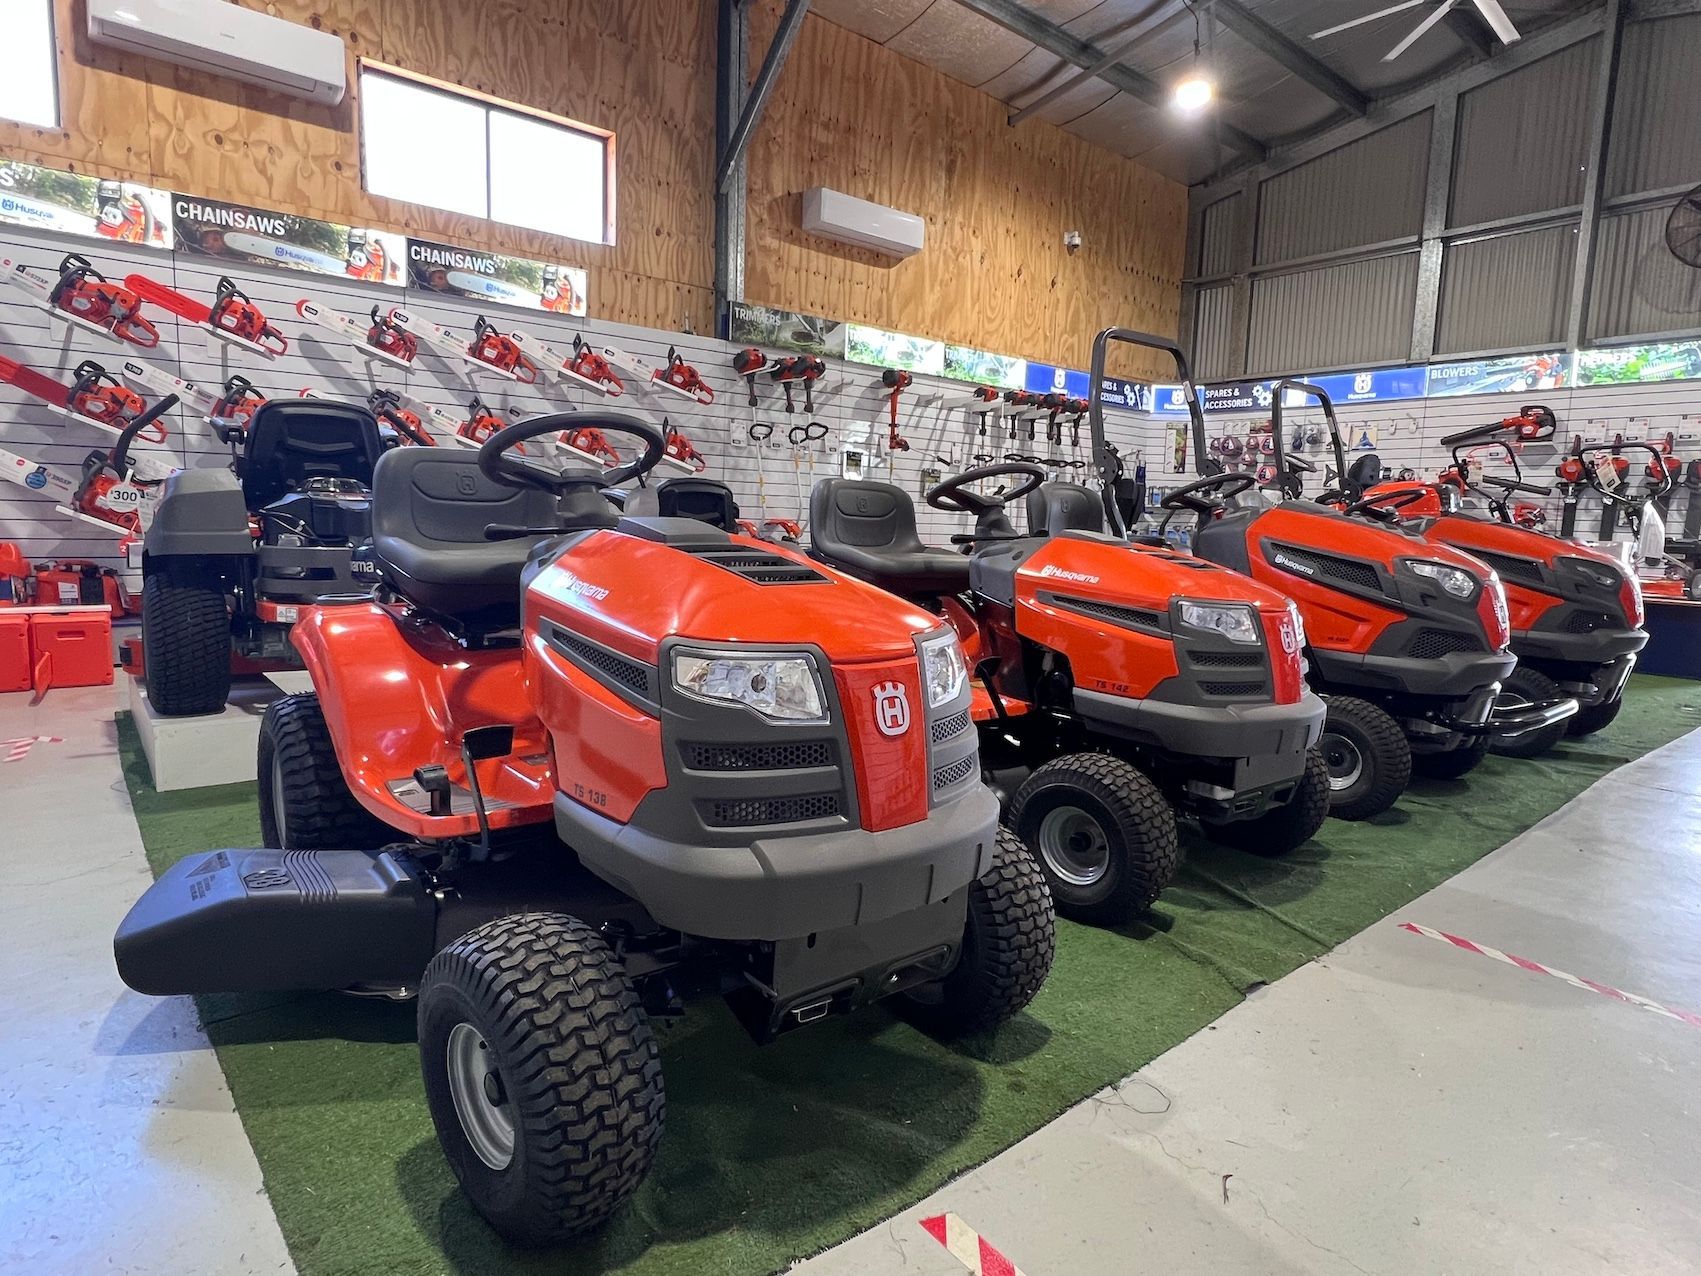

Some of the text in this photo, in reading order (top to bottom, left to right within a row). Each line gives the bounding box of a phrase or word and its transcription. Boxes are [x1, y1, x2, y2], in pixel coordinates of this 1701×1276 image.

[175, 201, 286, 236] CHAINSAWS
[411, 245, 495, 274] CHAINSAWS
[734, 307, 781, 326] TRIMMERS
[1431, 366, 1478, 379] BLOWERS
[1205, 387, 1240, 399] SPARES &
[1204, 398, 1253, 410] ACCESSORIES
[1282, 556, 1314, 575] Husqvarna
[1051, 566, 1100, 584] Husqvarna
[1112, 683, 1129, 693] 142
[574, 783, 607, 807] TS 138
